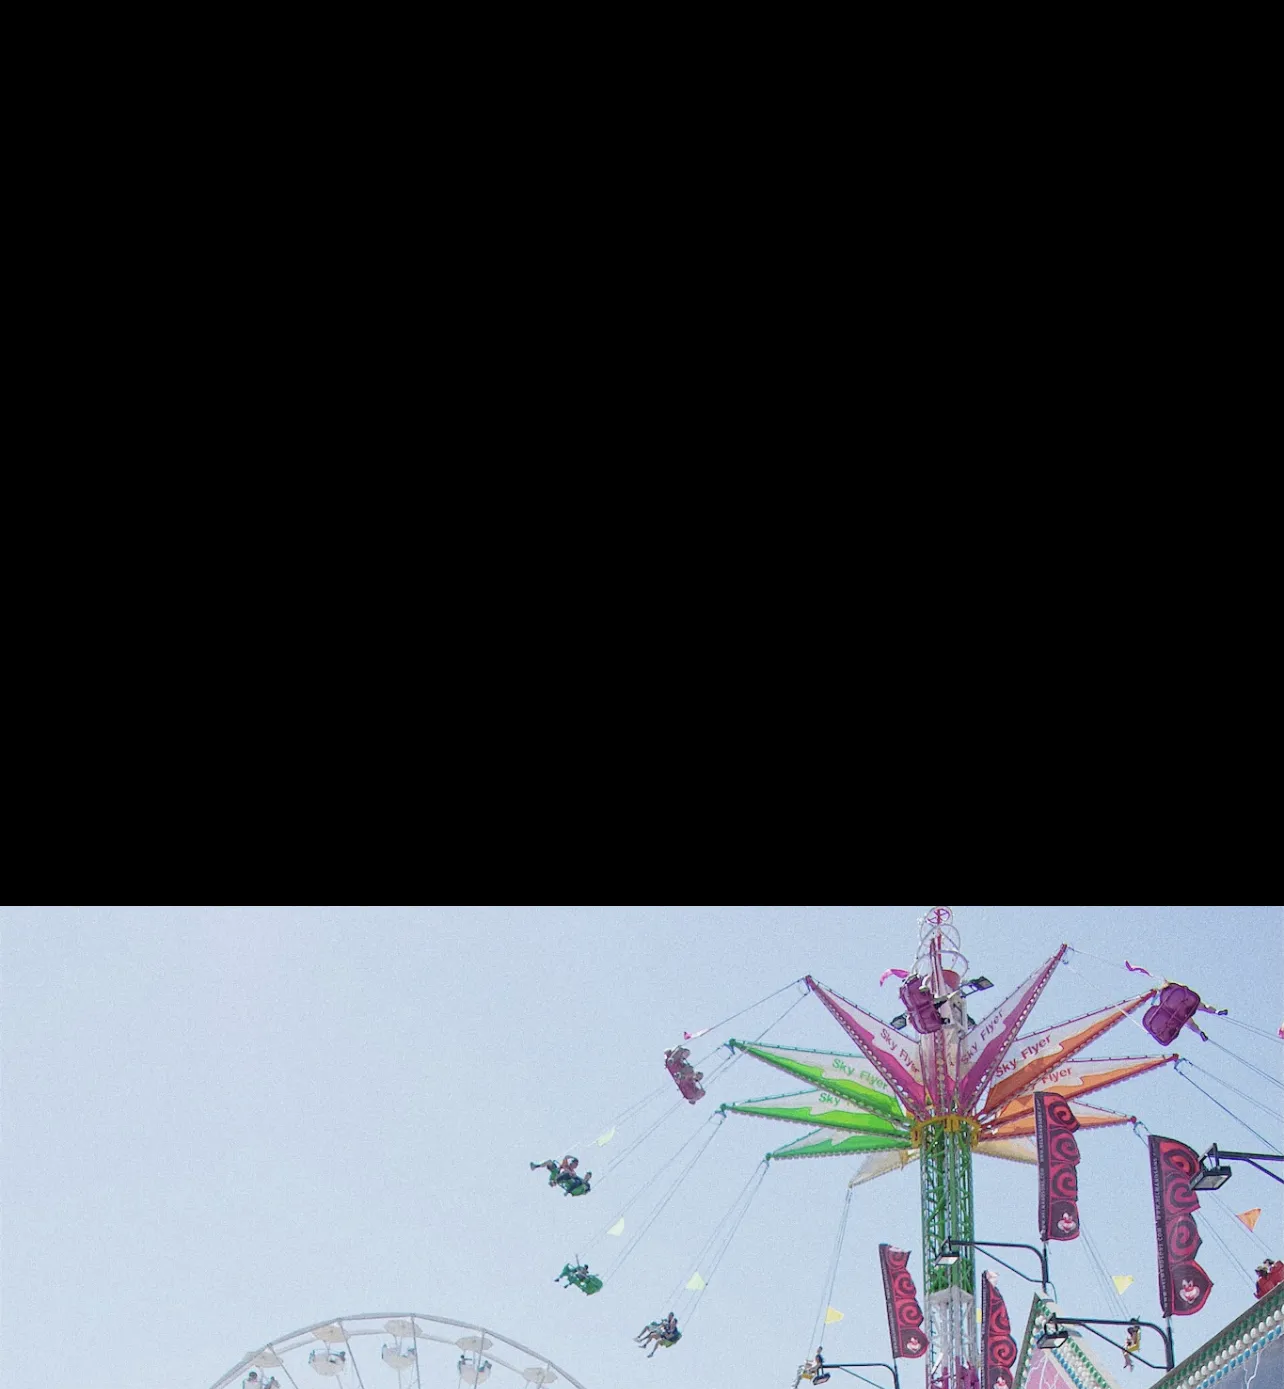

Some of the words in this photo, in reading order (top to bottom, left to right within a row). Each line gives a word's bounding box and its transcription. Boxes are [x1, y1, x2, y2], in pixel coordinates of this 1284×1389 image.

[880, 1028, 897, 1051] Sky
[900, 1049, 920, 1073] Flyer
[961, 1042, 978, 1065] Sky
[980, 1009, 1003, 1040] Flyer
[995, 1058, 1017, 1077] Sky
[1021, 1034, 1052, 1060] Flyer
[832, 1058, 855, 1076] Sky
[860, 1070, 888, 1089] Flyer
[1041, 1067, 1073, 1084] Flyer
[819, 1093, 840, 1106] Sky
